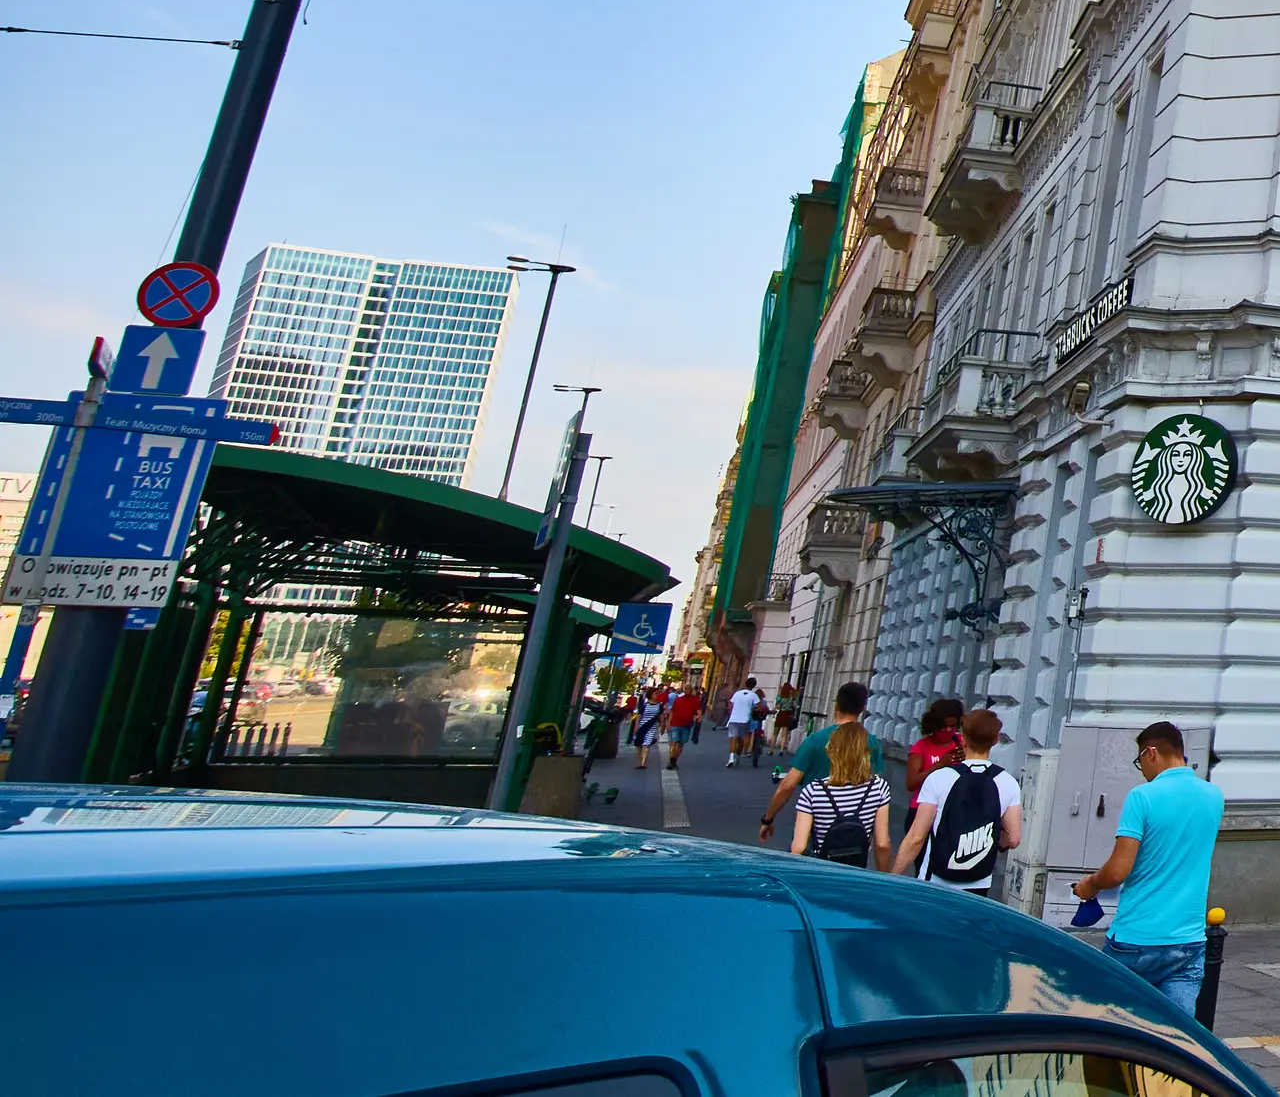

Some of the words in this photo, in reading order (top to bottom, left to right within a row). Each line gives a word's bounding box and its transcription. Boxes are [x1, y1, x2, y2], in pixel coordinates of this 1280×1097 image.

[1054, 308, 1096, 365] STARBUCKS
[1098, 279, 1129, 324] COFFEE
[35, 412, 65, 422] 300m
[105, 416, 129, 428] Teatr
[133, 419, 177, 434] Muzyczny
[180, 424, 207, 436] Roma
[240, 430, 266, 442] 150m
[138, 460, 174, 474] BUS
[132, 475, 171, 490] TAXI
[22, 557, 114, 580] Oowiązuje
[9, 586, 22, 597] w
